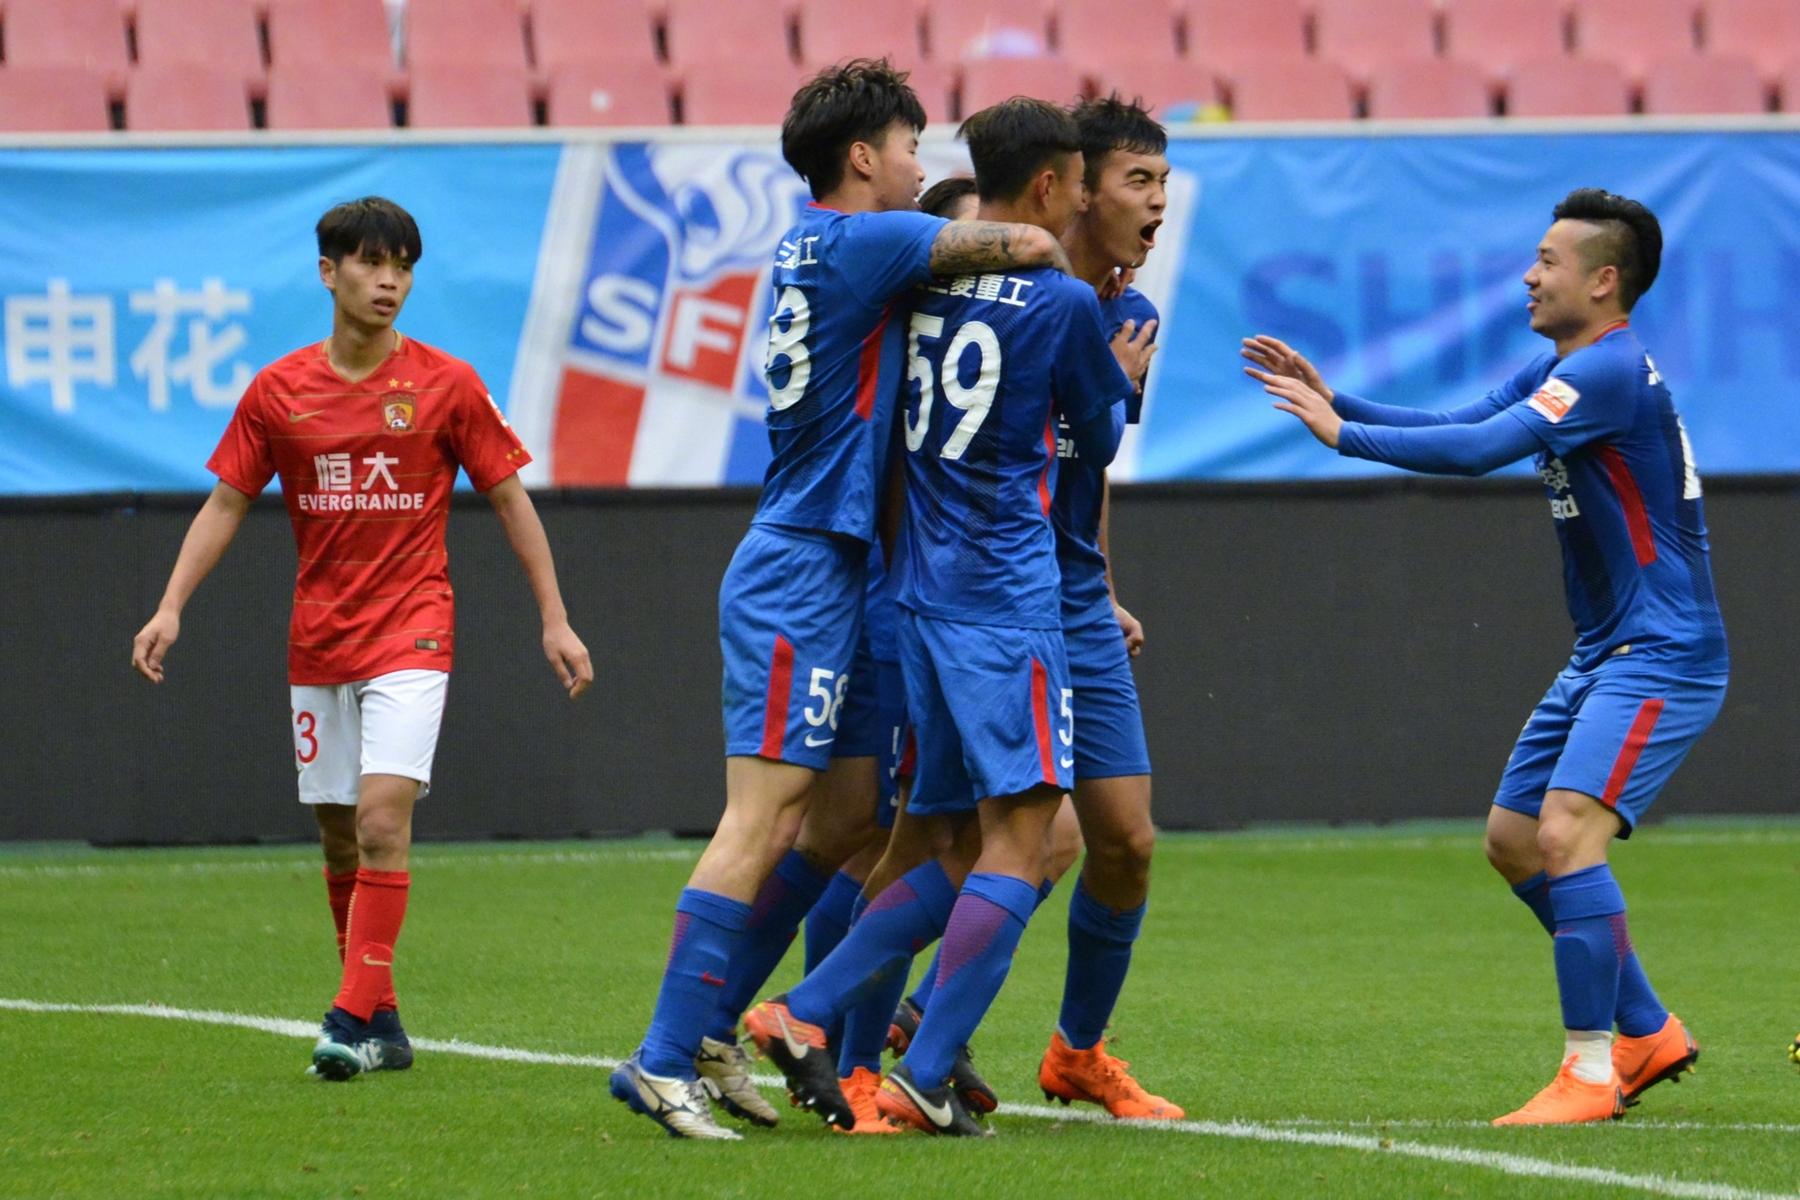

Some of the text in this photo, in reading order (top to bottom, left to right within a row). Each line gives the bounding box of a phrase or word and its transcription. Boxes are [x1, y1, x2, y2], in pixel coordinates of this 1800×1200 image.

[5, 277, 253, 412] 申花
[764, 285, 811, 411] 8
[904, 312, 1001, 459] 59
[298, 493, 425, 510] EVERGRANDE
[314, 452, 399, 491] 恒大
[804, 667, 849, 731] 58
[292, 709, 318, 763] 3
